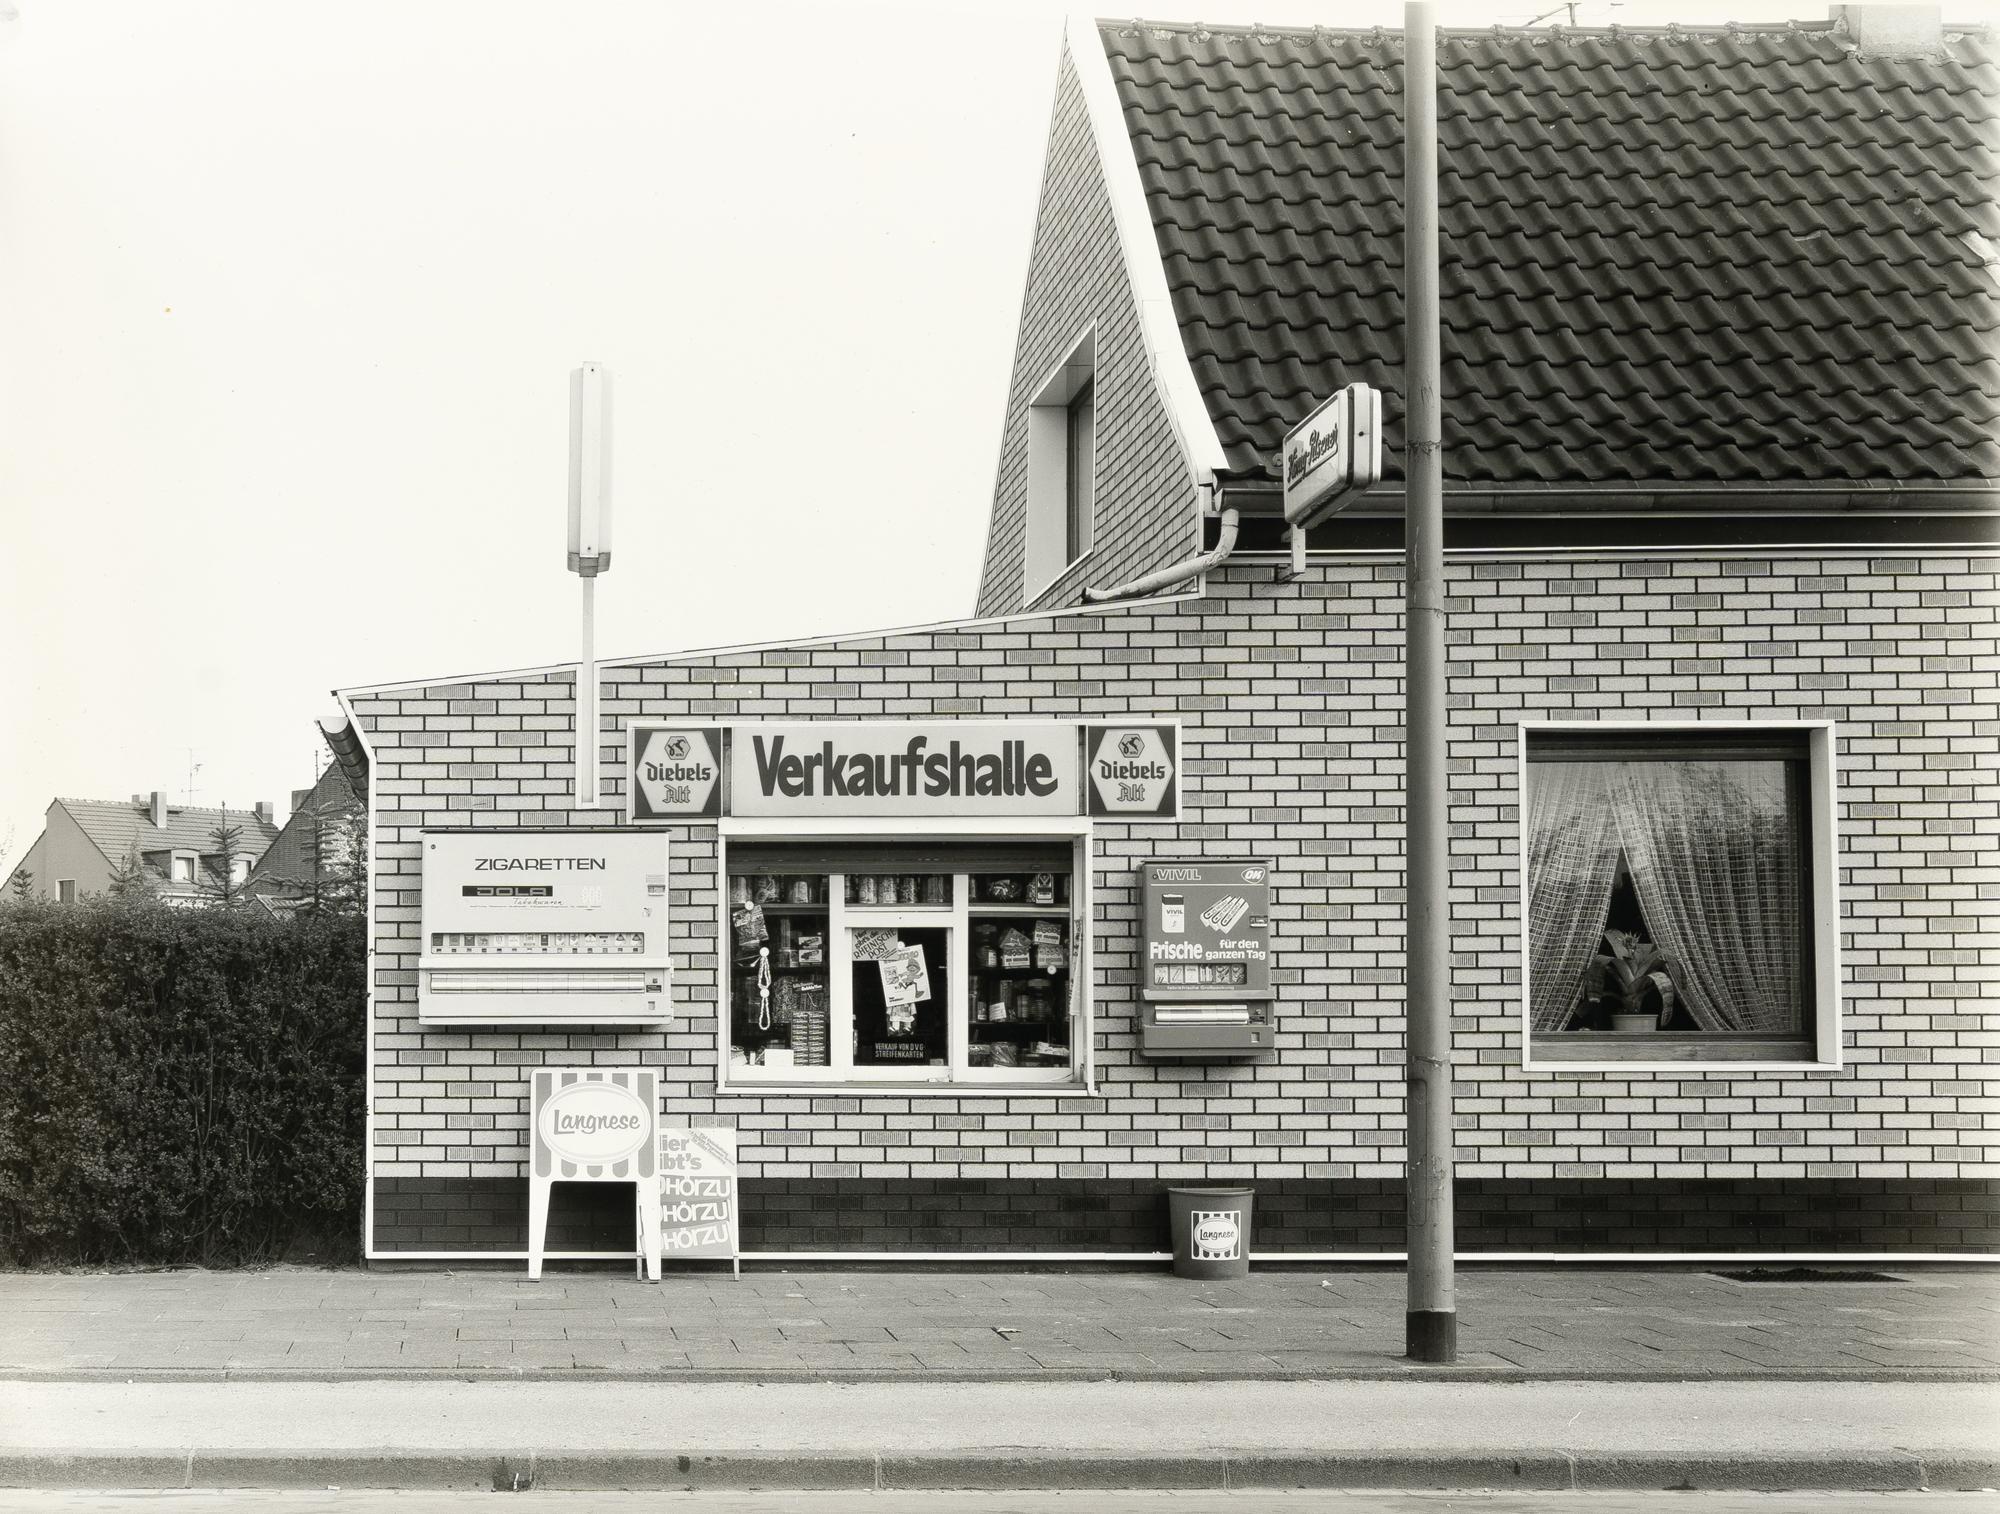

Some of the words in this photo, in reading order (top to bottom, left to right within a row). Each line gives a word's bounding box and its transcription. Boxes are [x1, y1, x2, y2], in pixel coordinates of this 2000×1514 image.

[752, 735, 1058, 797] Verkaufshalle
[662, 784, 691, 803] Alt
[1116, 782, 1146, 802] Alt
[474, 858, 606, 871] ZIGARETTEN
[1156, 868, 1202, 881] VIVIL
[853, 928, 896, 959] RHEINISCHE
[868, 943, 888, 959] POST
[1150, 941, 1203, 960] Frische
[1219, 939, 1237, 949] für
[1237, 939, 1259, 949] den
[1205, 951, 1245, 961] ganzen
[1246, 950, 1266, 961] Tag
[875, 1050, 924, 1058] STREIFENKARTEN
[553, 1109, 640, 1136] Langnese
[659, 1134, 690, 1151] ier
[659, 1152, 702, 1170] ibt's
[1199, 1228, 1235, 1241] Langnese
